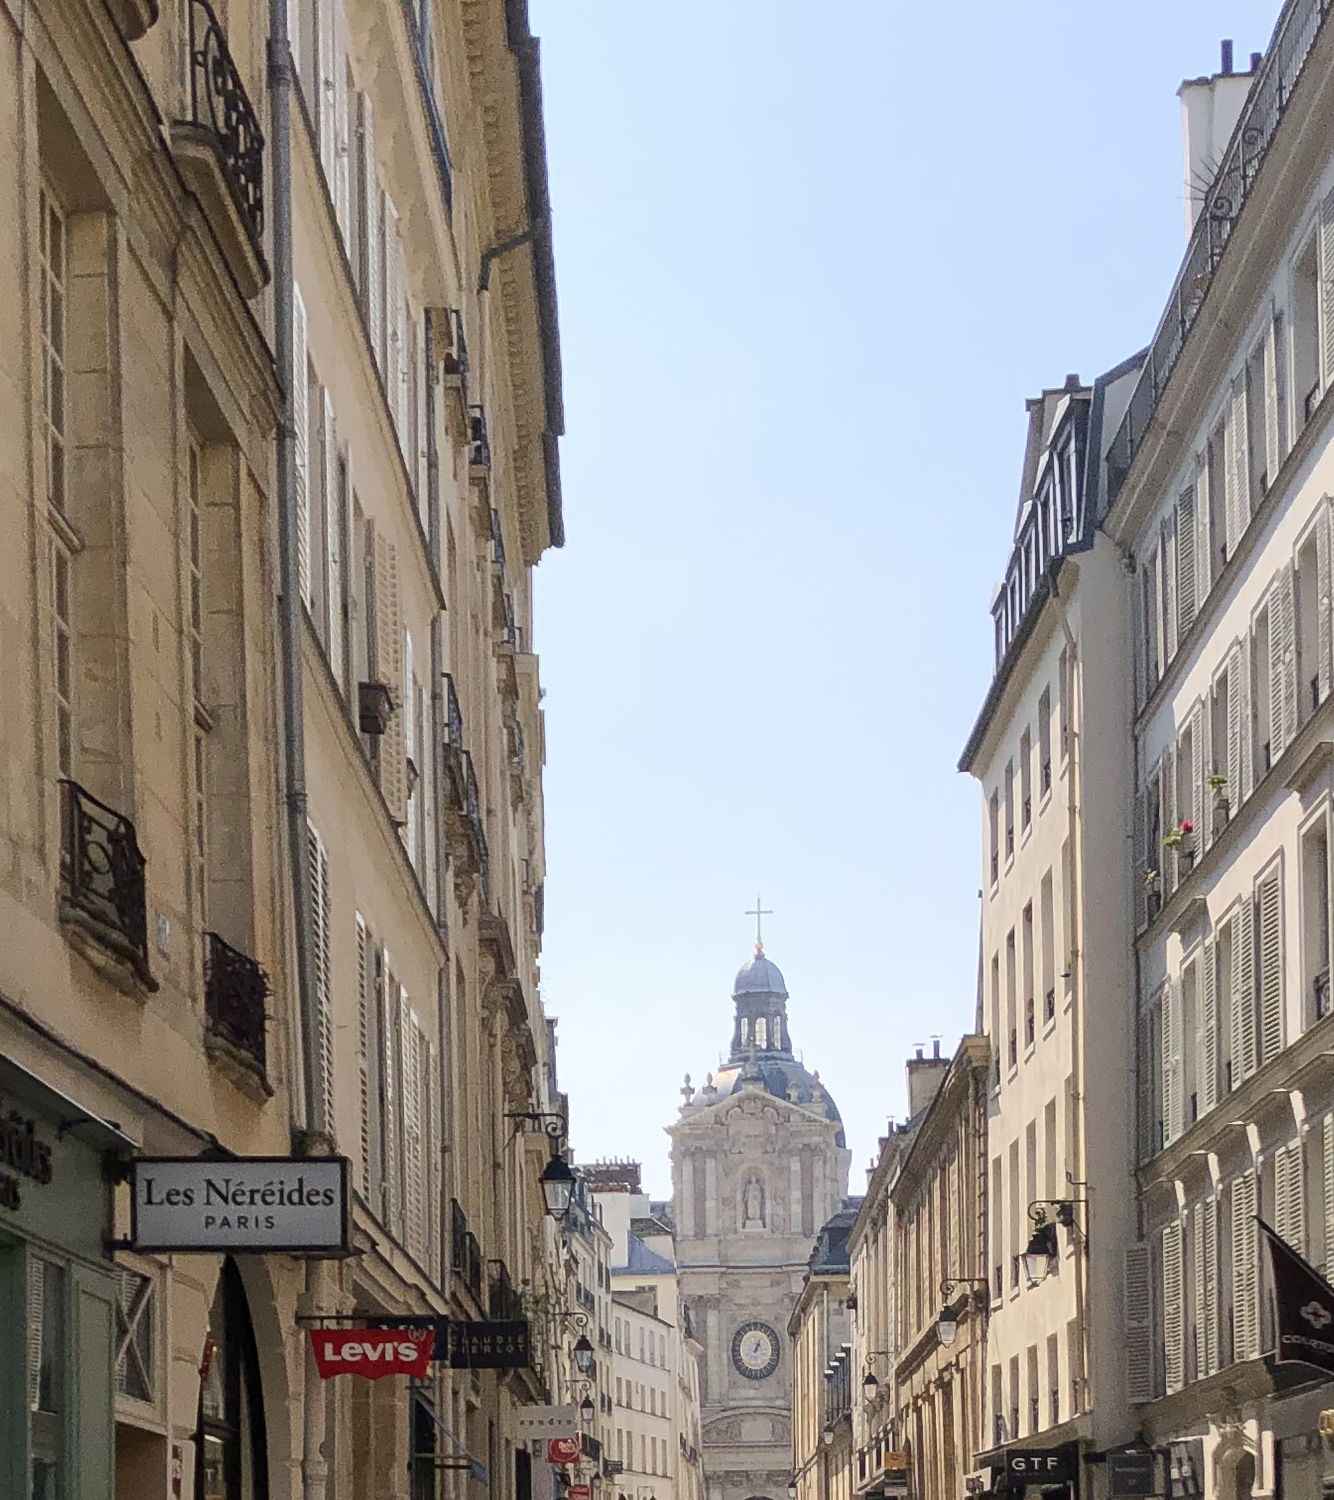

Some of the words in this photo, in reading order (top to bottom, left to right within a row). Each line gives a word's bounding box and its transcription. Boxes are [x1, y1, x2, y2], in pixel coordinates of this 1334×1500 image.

[143, 1178, 195, 1206] Les
[204, 1177, 335, 1206] Néréides
[205, 1215, 275, 1229] PARIS
[1011, 1457, 1058, 1471] GTF
